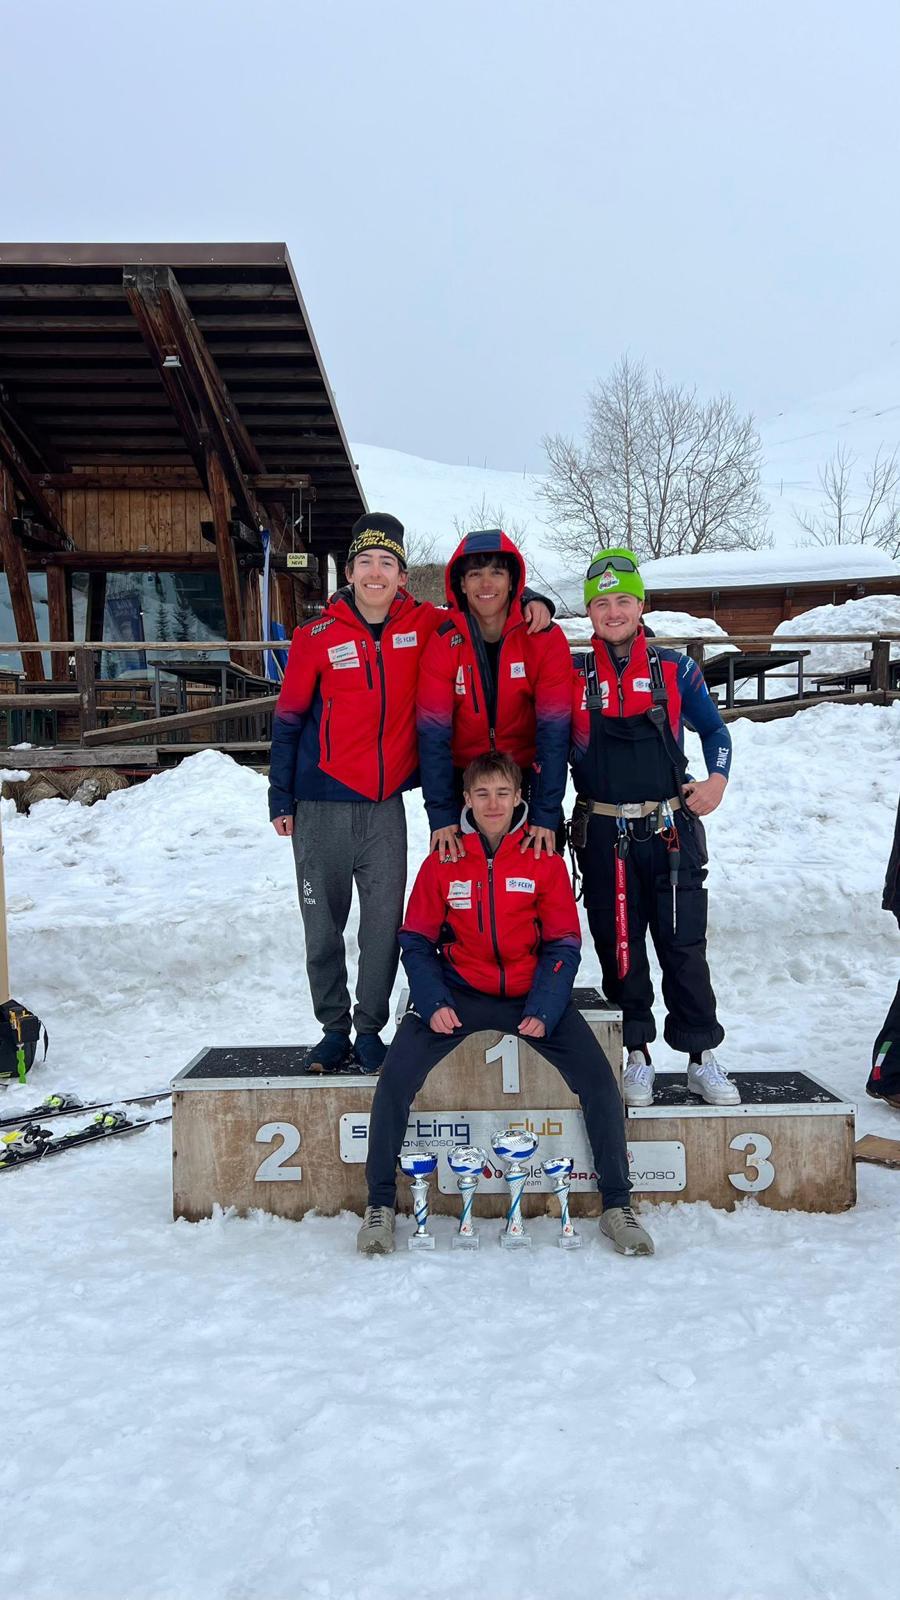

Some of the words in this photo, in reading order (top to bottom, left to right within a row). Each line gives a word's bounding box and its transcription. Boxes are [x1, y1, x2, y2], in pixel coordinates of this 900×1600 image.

[716, 747, 729, 768] FRANCE
[485, 1034, 520, 1094] 1
[254, 1121, 302, 1182] 2
[728, 1132, 775, 1192] 3
